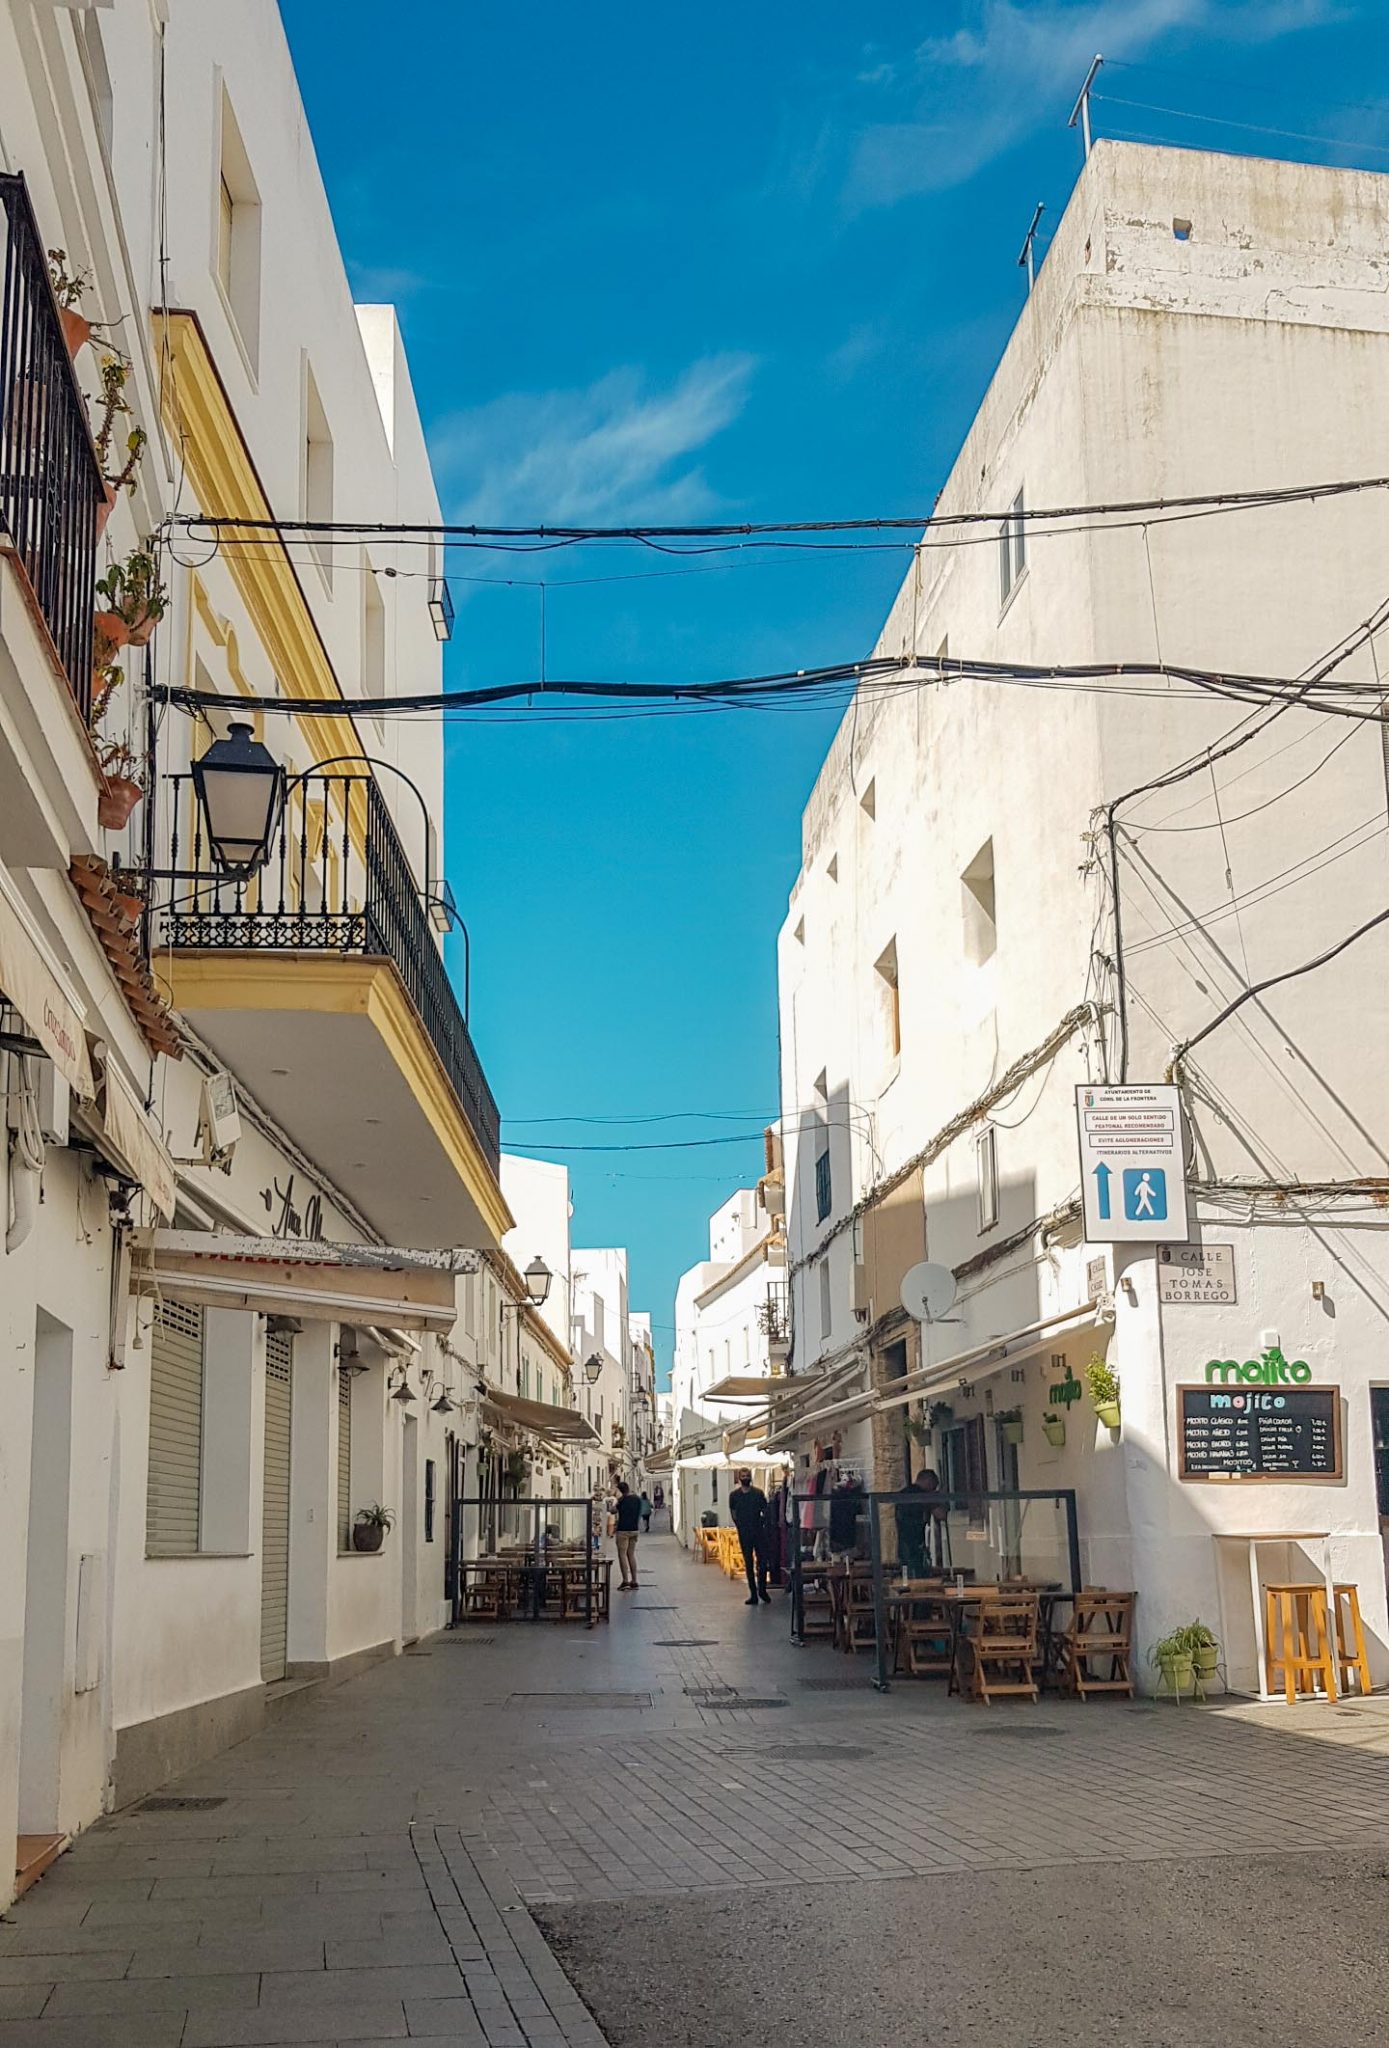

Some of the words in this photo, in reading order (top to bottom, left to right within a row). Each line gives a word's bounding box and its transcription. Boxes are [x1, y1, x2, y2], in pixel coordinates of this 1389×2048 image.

[1180, 1251, 1223, 1262] CALLE
[1181, 1267, 1213, 1277] JOSE
[1169, 1279, 1224, 1289] TOMAS
[1165, 1290, 1229, 1300] BORREGO
[1205, 1350, 1312, 1384] mojito
[1211, 1392, 1285, 1414] mojito
